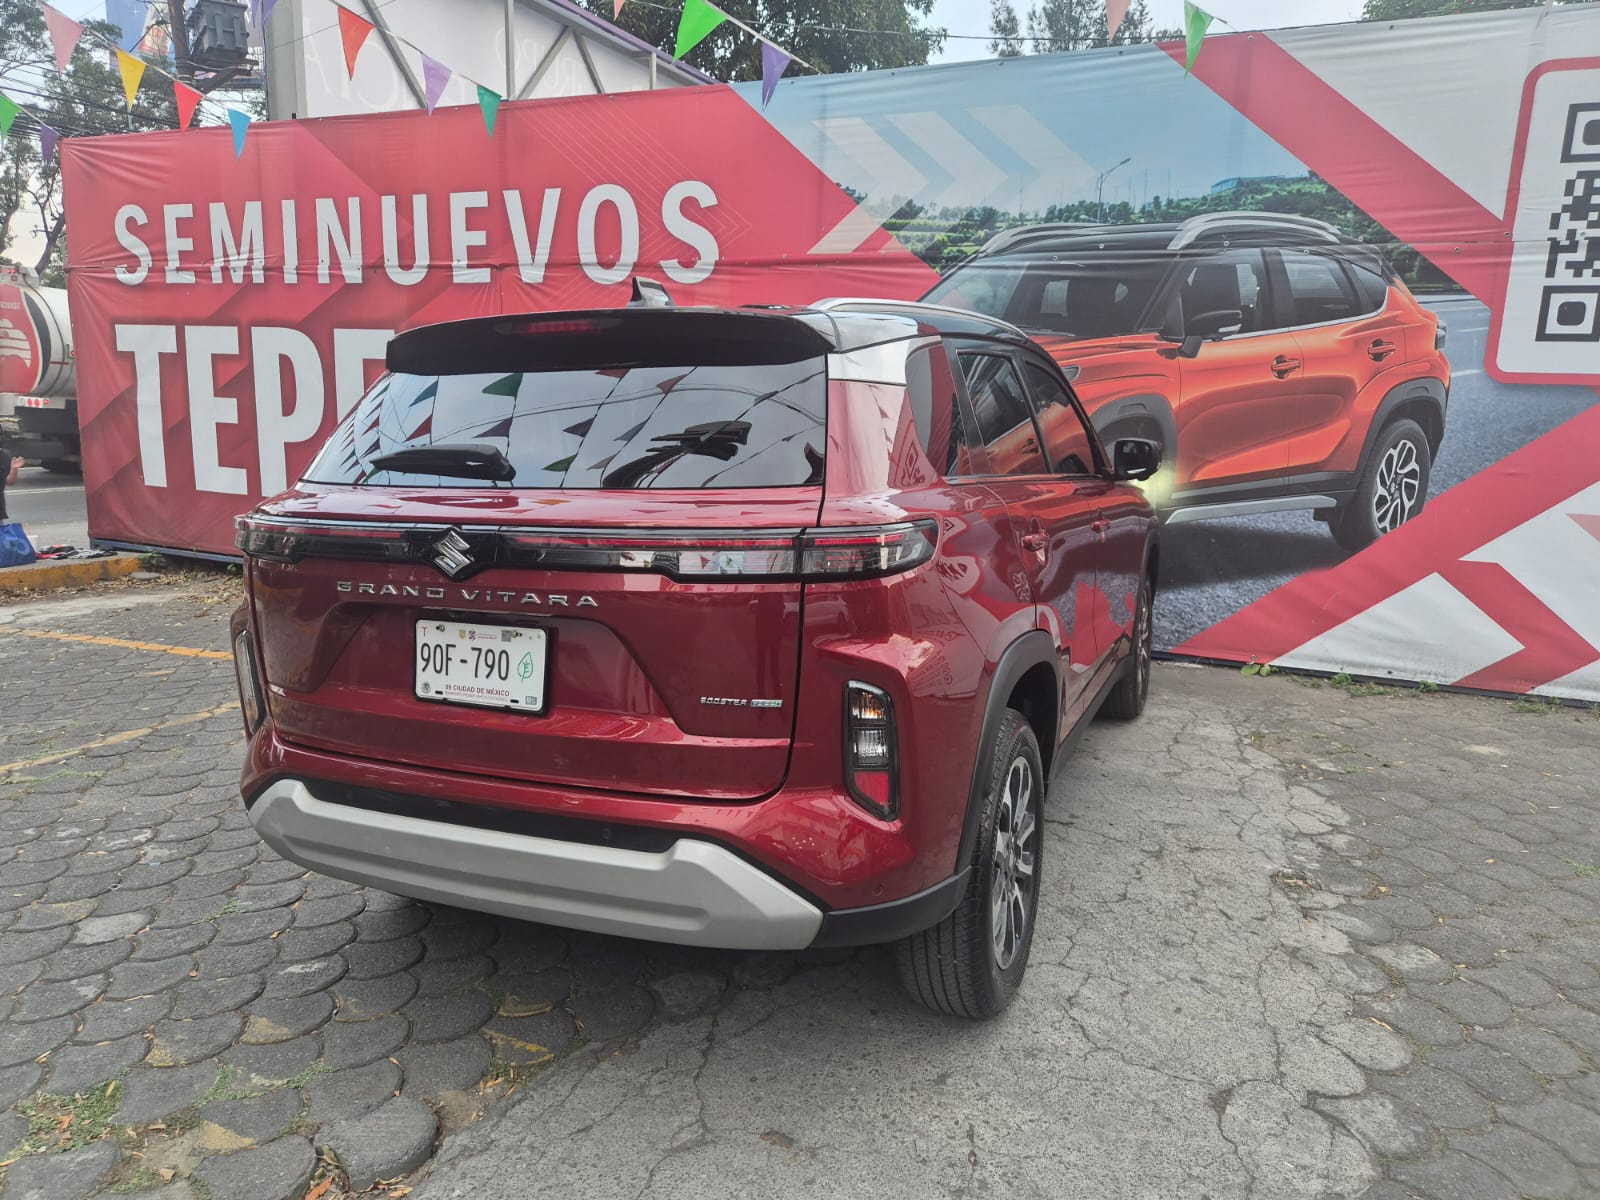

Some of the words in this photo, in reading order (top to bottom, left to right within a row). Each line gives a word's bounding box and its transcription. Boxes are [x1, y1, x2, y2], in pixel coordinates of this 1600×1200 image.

[114, 180, 719, 286] SEMINUEVOS
[337, 581, 444, 599] GRAND
[420, 642, 510, 681] 90F-790
[452, 685, 475, 693] CIUDAD
[486, 688, 510, 697] MÉXICO
